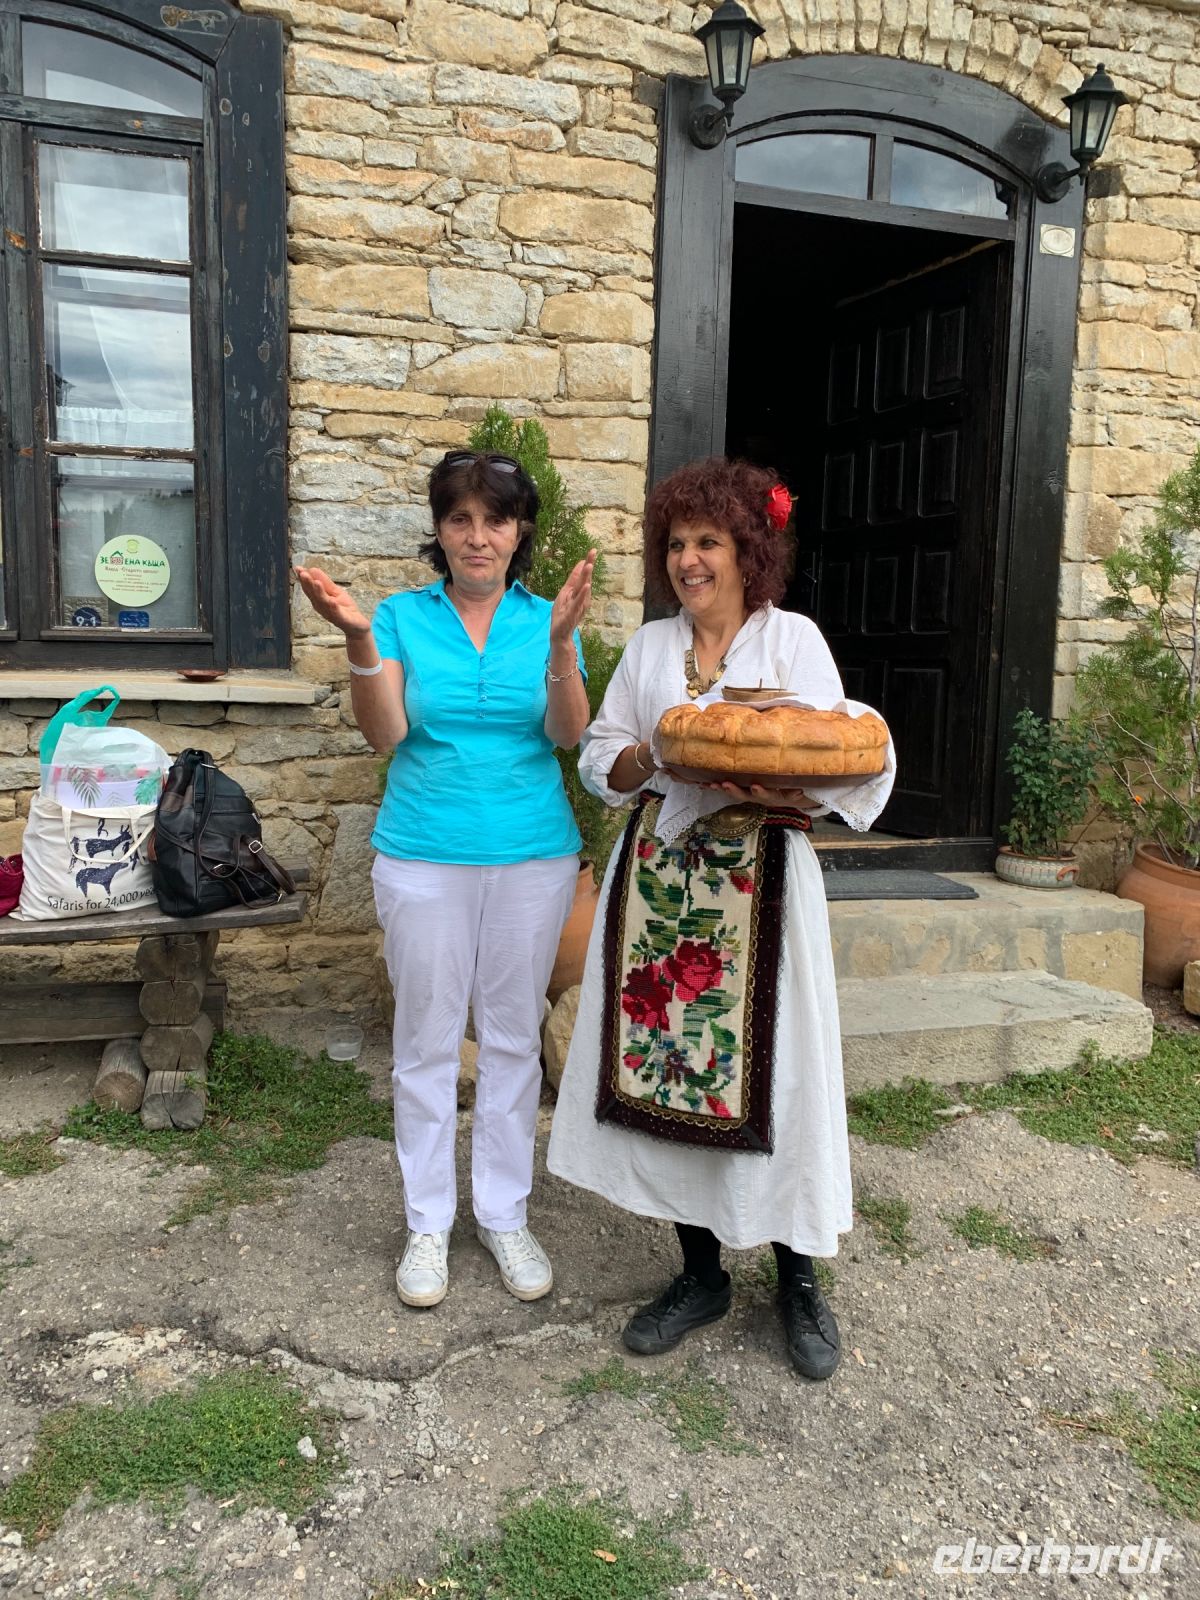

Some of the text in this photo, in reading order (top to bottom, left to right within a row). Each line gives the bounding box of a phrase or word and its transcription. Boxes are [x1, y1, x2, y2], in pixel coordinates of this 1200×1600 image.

[47, 896, 83, 911] Safaris
[86, 899, 101, 909] for
[104, 891, 138, 908] 24,000
